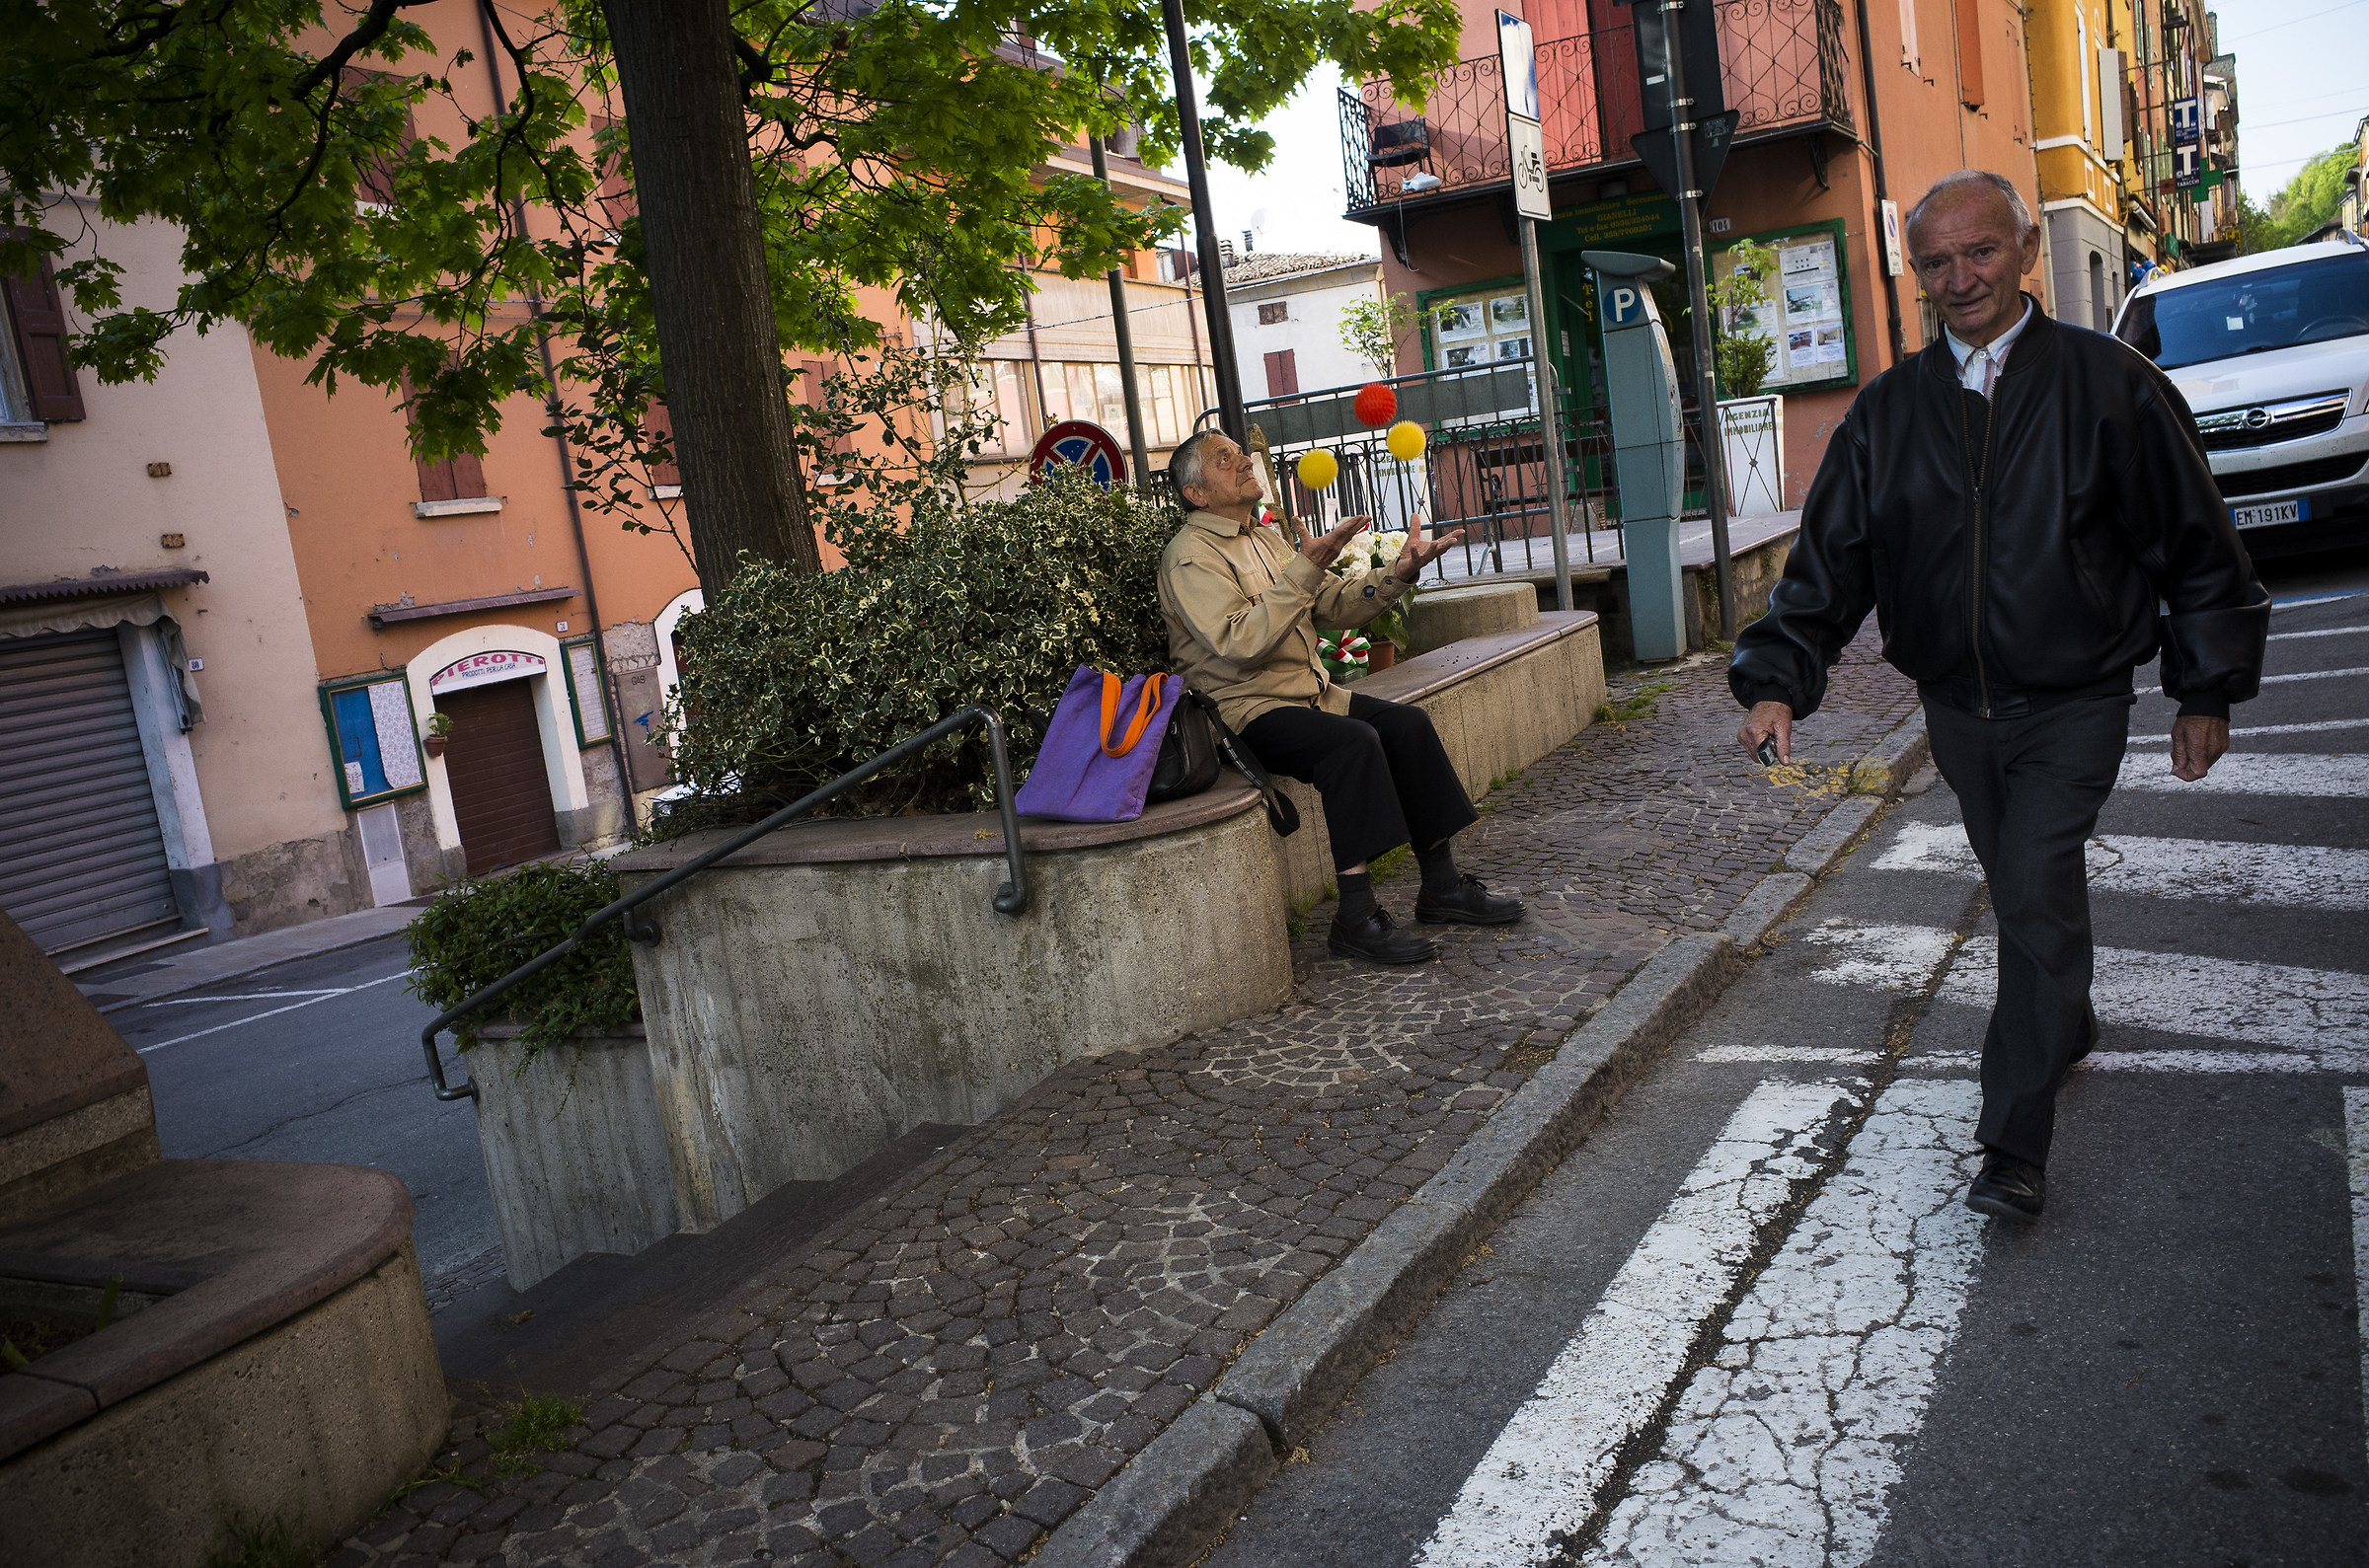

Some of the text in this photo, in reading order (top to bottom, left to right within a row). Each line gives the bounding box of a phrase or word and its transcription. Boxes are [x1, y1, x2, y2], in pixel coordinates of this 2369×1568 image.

[2175, 99, 2196, 129] T
[2177, 144, 2197, 176] T
[1613, 287, 1636, 323] P
[1723, 421, 1774, 437] IMMOBILIARE
[1724, 409, 1771, 422] AGENZIA
[431, 653, 545, 686] PIEROTTI
[461, 668, 486, 678] PRODOTTI
[503, 662, 516, 671] CASA
